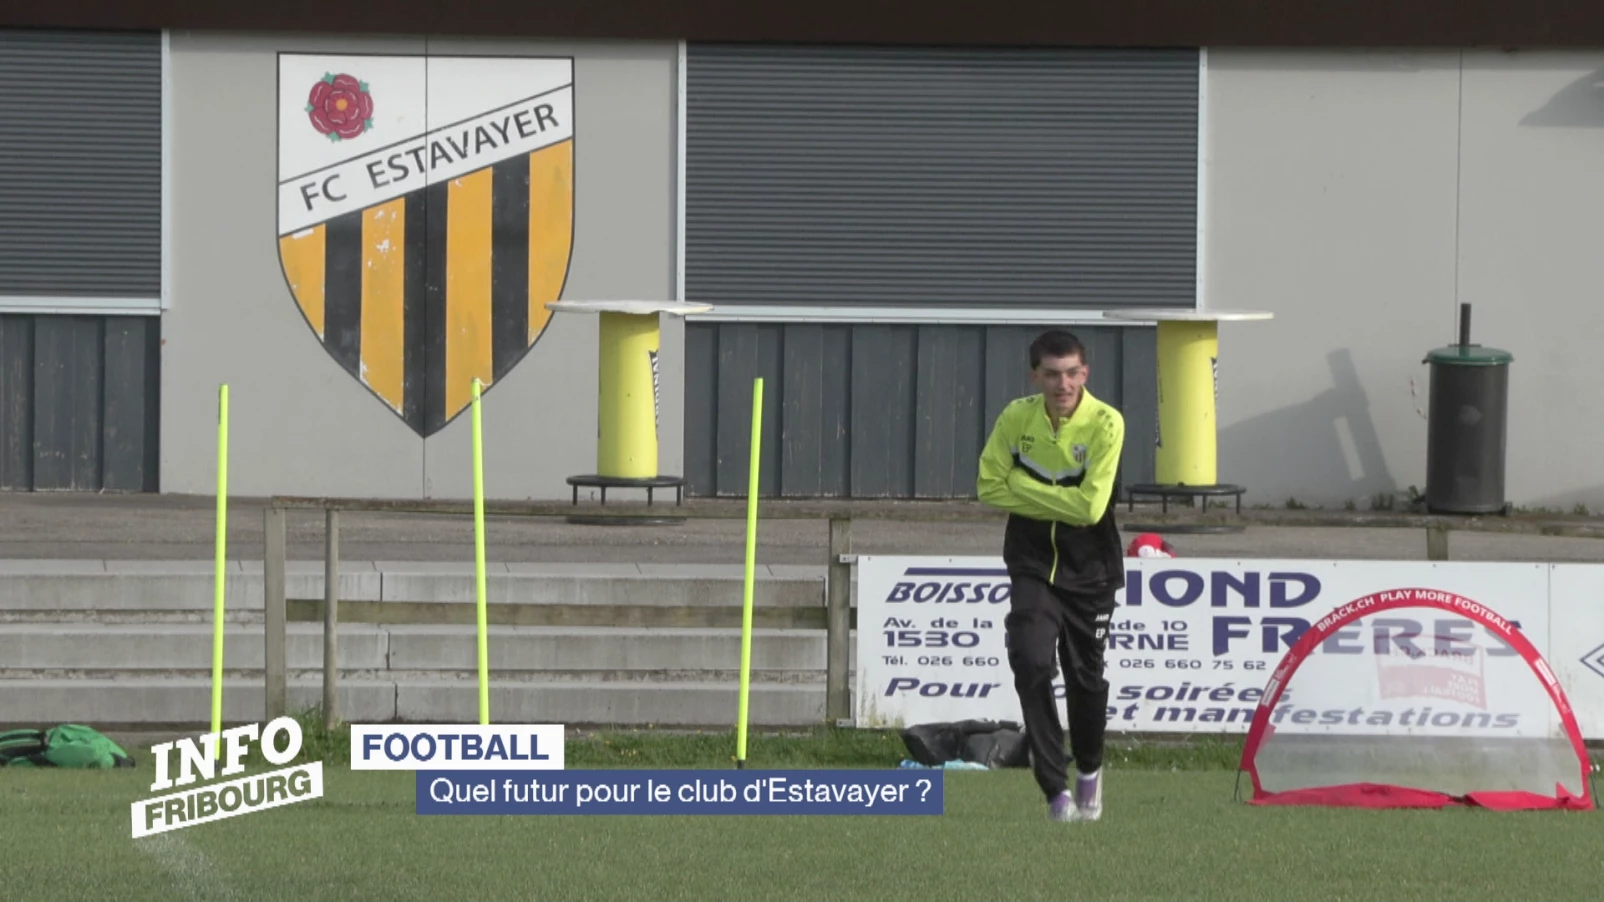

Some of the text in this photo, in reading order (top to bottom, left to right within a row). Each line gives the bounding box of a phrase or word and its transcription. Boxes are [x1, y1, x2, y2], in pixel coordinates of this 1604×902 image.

[300, 103, 559, 211] FC ESTAVAYER
[885, 582, 1012, 604] BOISSO
[1114, 570, 1321, 608] IOND
[1380, 589, 1412, 603] PLAY
[1415, 589, 1453, 604] MORE
[1454, 596, 1512, 635] FOOTBALL
[883, 617, 916, 628] Av.
[930, 617, 959, 628] de
[973, 618, 993, 629] la
[1162, 621, 1188, 631] 10
[883, 631, 980, 647] 1530
[882, 656, 908, 666] Tél.
[918, 656, 953, 666] 026
[962, 656, 1000, 667] 660
[1119, 658, 1155, 669] 026
[1164, 659, 1202, 670] 660
[1212, 660, 1234, 670] 75
[1243, 660, 1267, 671] 62
[884, 677, 1002, 698] Pour
[1105, 702, 1521, 729] et manfestations
